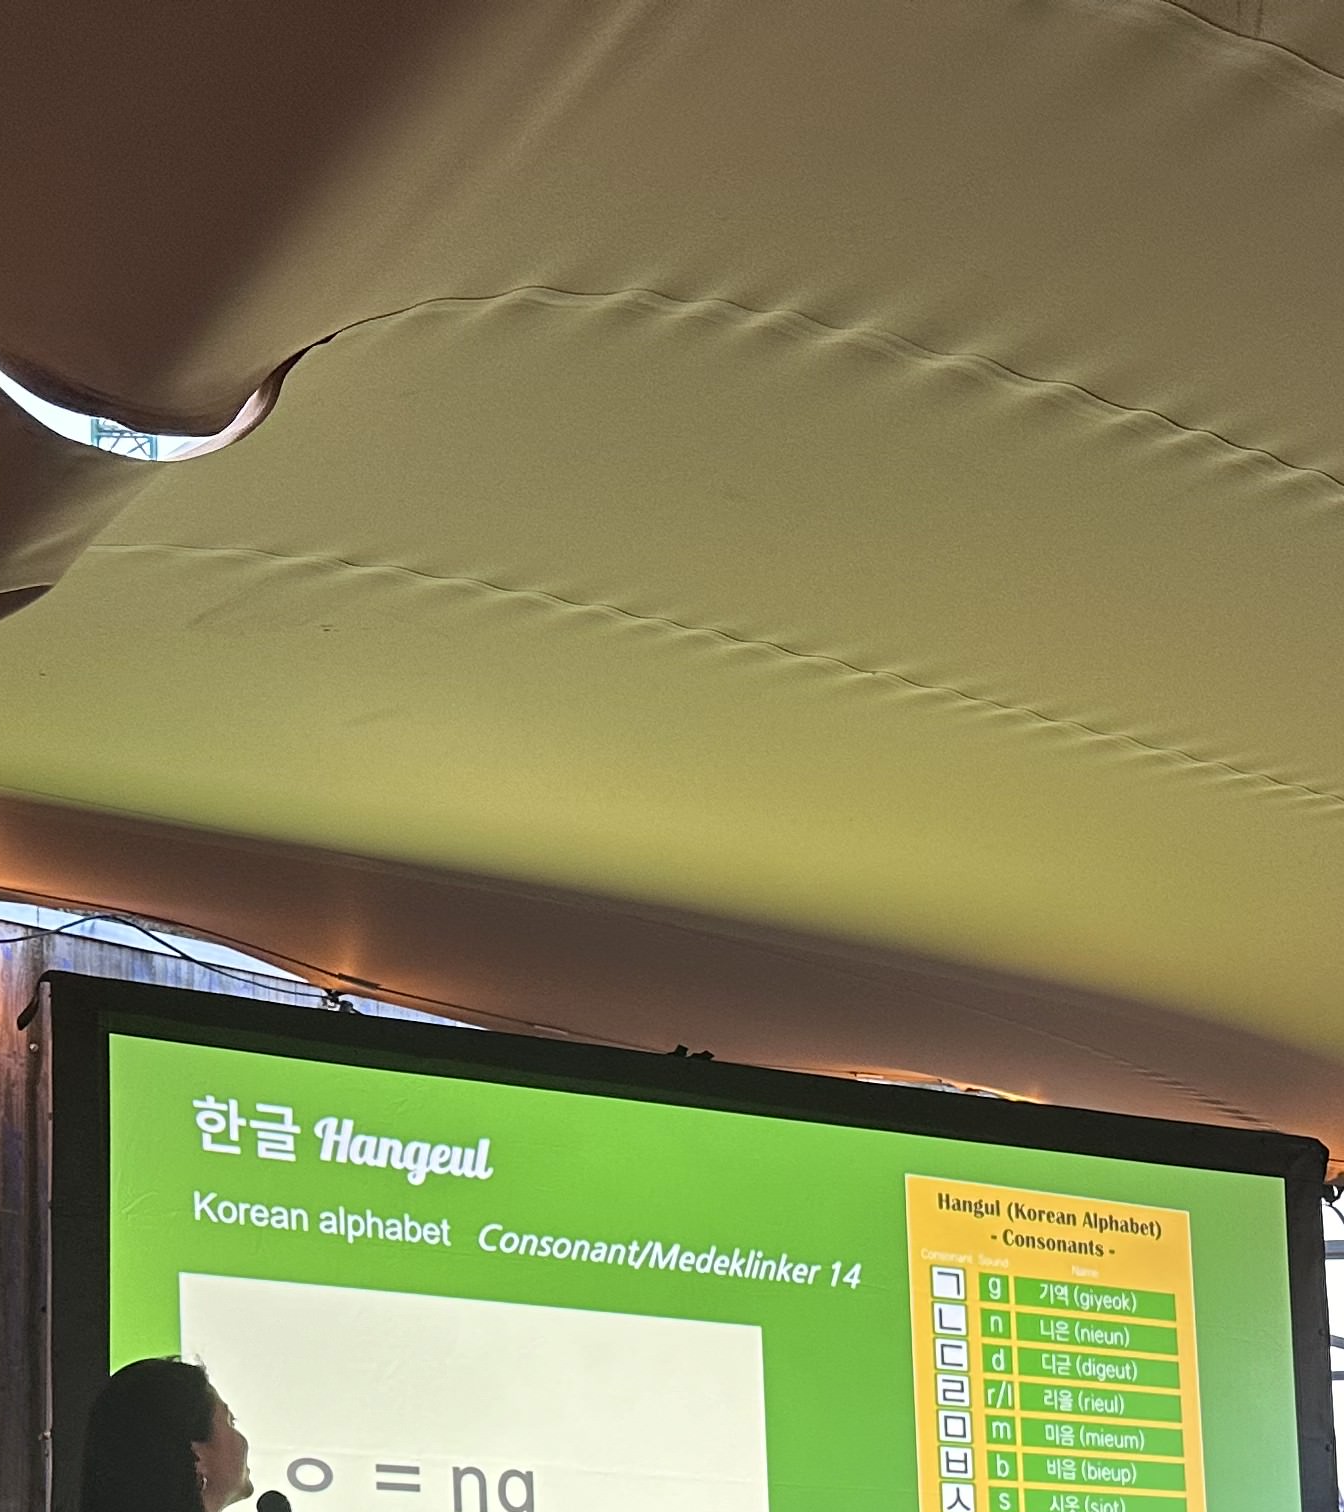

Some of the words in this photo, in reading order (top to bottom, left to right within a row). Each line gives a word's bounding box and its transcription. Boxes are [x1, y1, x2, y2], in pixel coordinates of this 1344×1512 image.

[193, 1095, 301, 1163] 한글
[315, 1116, 493, 1186] Hangeul
[937, 1193, 1001, 1218] Hangul
[1007, 1202, 1077, 1227] (Korean
[1082, 1211, 1162, 1240] Alphabet)
[193, 1192, 308, 1233] Korean
[320, 1202, 451, 1248] alphabet
[478, 1224, 820, 1287] Consonant/Medeklinker
[828, 1262, 861, 1290] 14
[1002, 1230, 1104, 1257] Consonants
[988, 1276, 1001, 1299] g
[1039, 1283, 1068, 1306] 기역
[1074, 1285, 1137, 1313] (giyeok)
[989, 1314, 1002, 1334] n
[1040, 1319, 1070, 1342] 니은
[1074, 1321, 1130, 1348] (nieun)
[992, 1349, 1005, 1370] d
[1042, 1353, 1071, 1376] 디귿
[1076, 1355, 1138, 1382] (digeut)
[987, 1382, 1012, 1407] r/l
[1044, 1389, 1073, 1409] 리을
[1077, 1390, 1125, 1415] (rieul)
[992, 1421, 1011, 1439] m
[1045, 1423, 1074, 1446] 미음
[1079, 1426, 1144, 1451] (mieum)
[996, 1454, 1009, 1477] b
[1047, 1458, 1077, 1481] 비읍
[1081, 1460, 1137, 1485] (bieup)
[998, 1494, 1010, 1511] s
